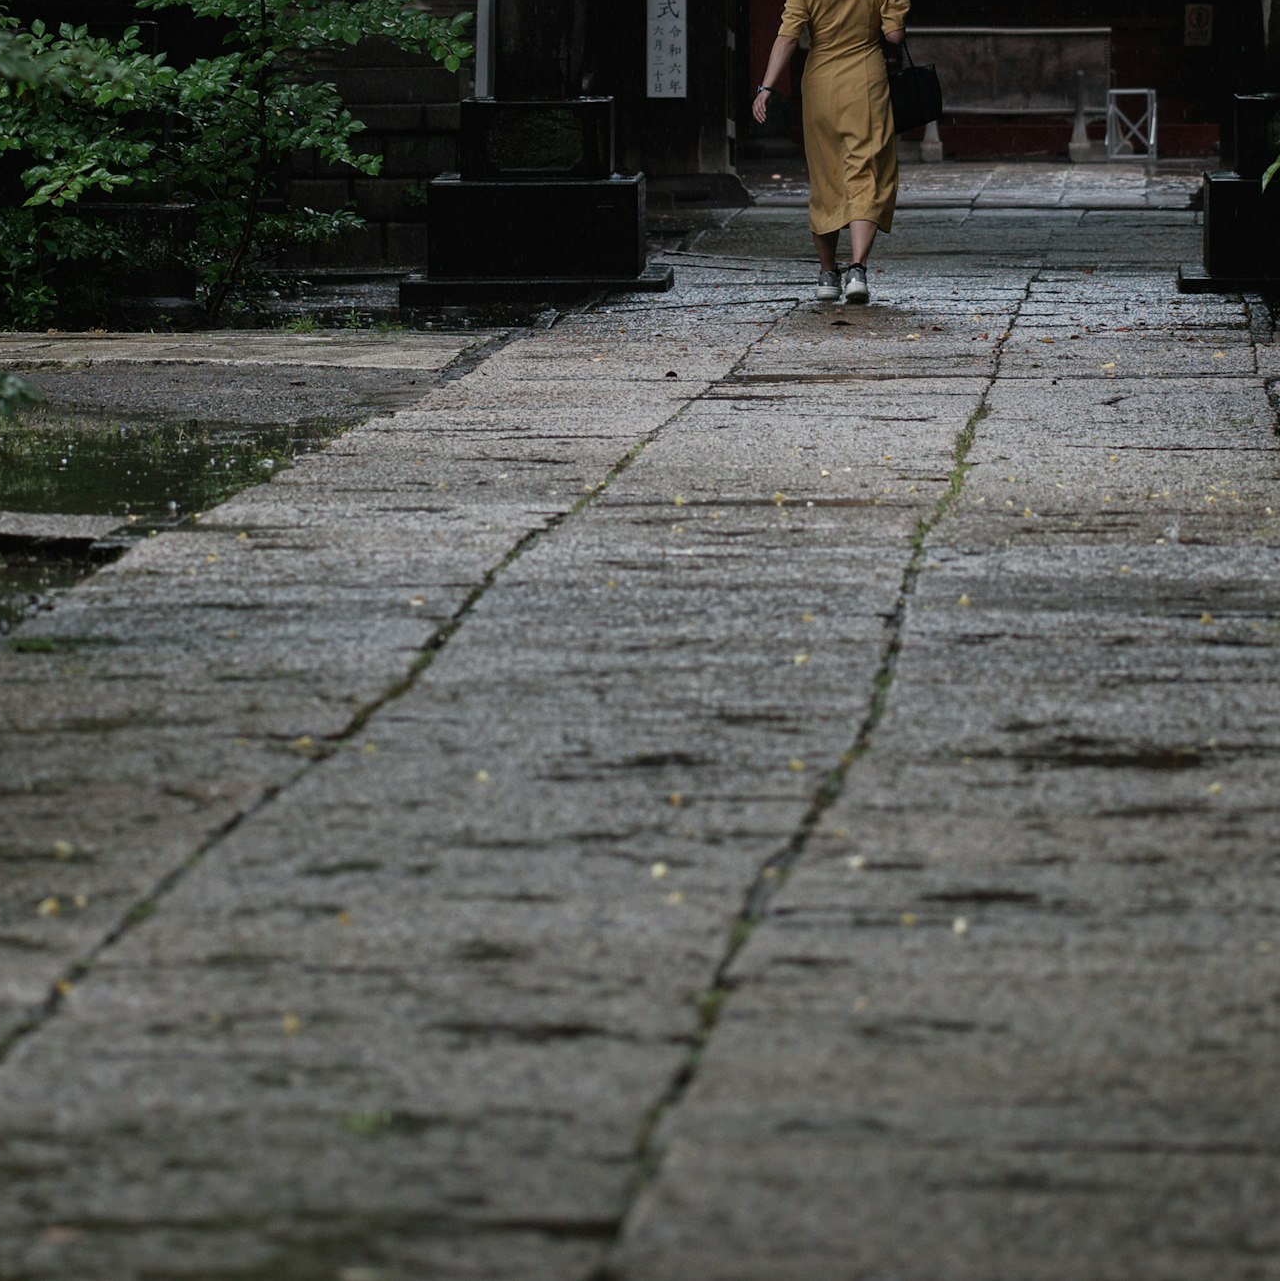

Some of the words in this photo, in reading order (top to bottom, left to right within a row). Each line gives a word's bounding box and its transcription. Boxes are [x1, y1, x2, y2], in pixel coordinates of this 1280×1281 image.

[653, 26, 664, 93] 六月三十日
[669, 25, 682, 94] 令和六年
